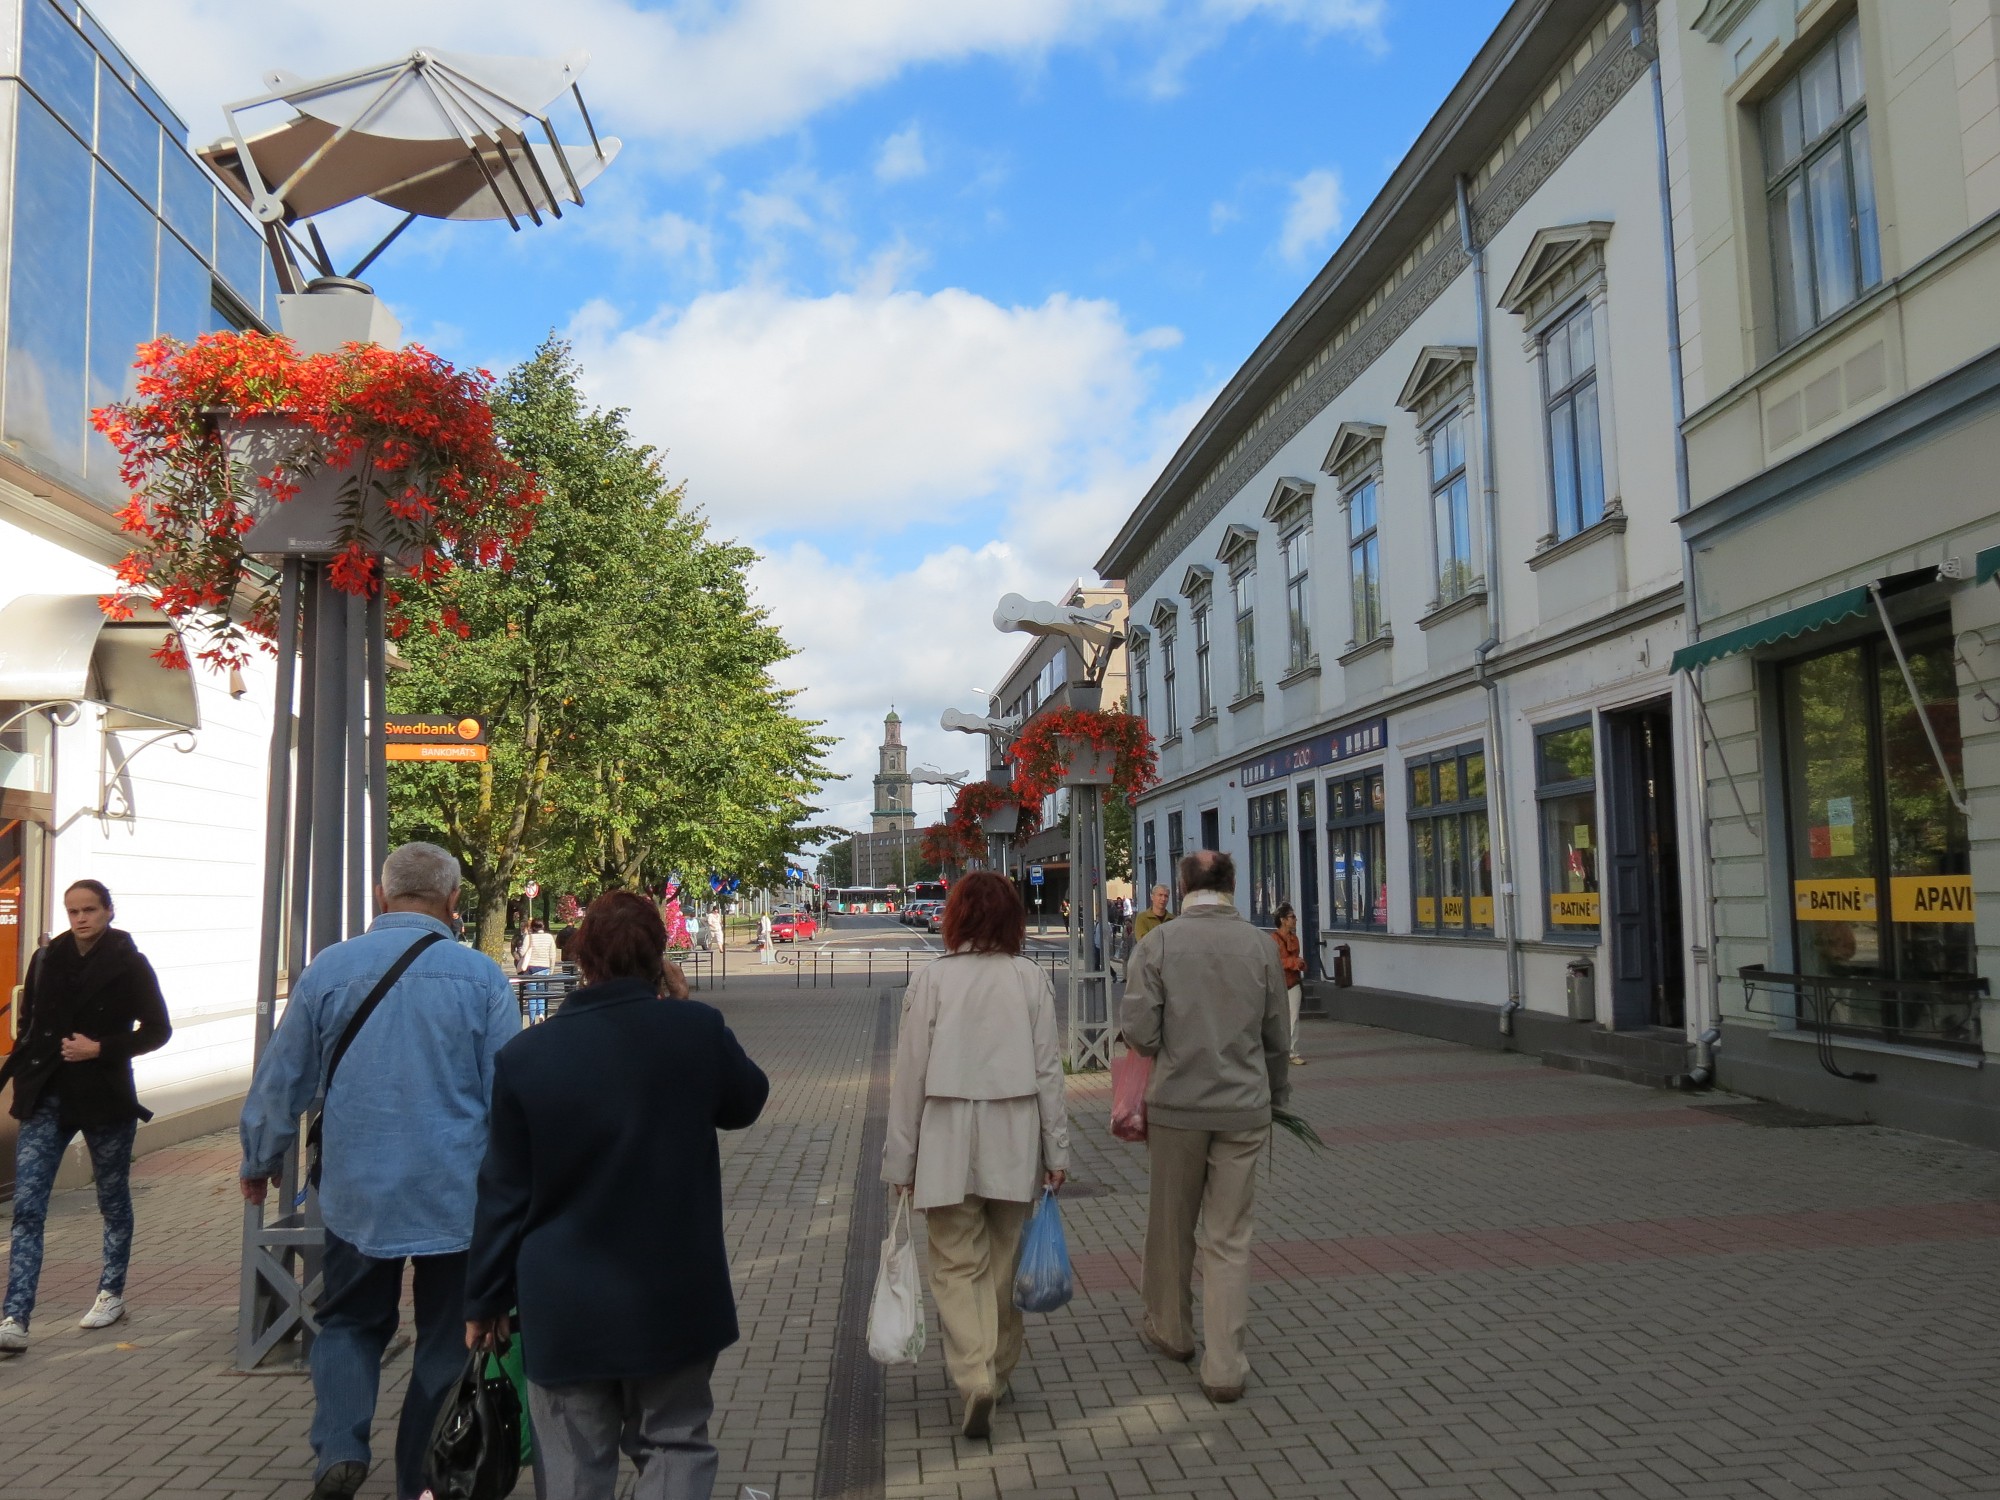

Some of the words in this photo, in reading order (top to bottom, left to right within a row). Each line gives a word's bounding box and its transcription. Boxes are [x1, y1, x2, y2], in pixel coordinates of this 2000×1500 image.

[384, 722, 456, 735] Swedbank
[421, 747, 476, 757] BANKOMĀTS
[1914, 886, 1972, 911] APAVI
[1444, 902, 1462, 917] APAV
